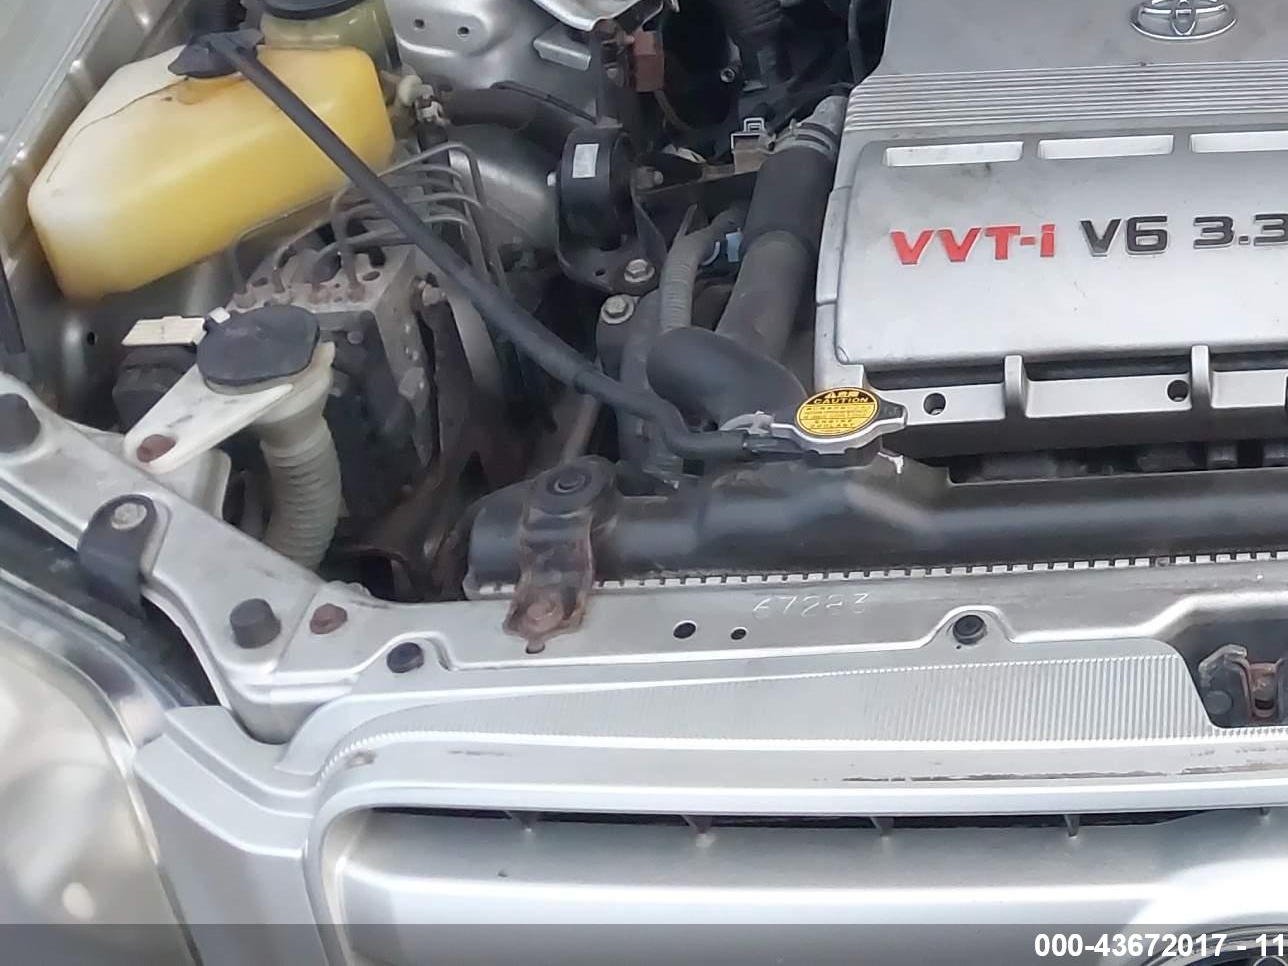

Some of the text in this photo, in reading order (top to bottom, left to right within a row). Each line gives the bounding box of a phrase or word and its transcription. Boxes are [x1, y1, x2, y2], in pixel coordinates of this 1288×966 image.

[890, 223, 1057, 265] VVT-i
[1080, 216, 1168, 258] V6
[813, 397, 869, 405] CAUTION
